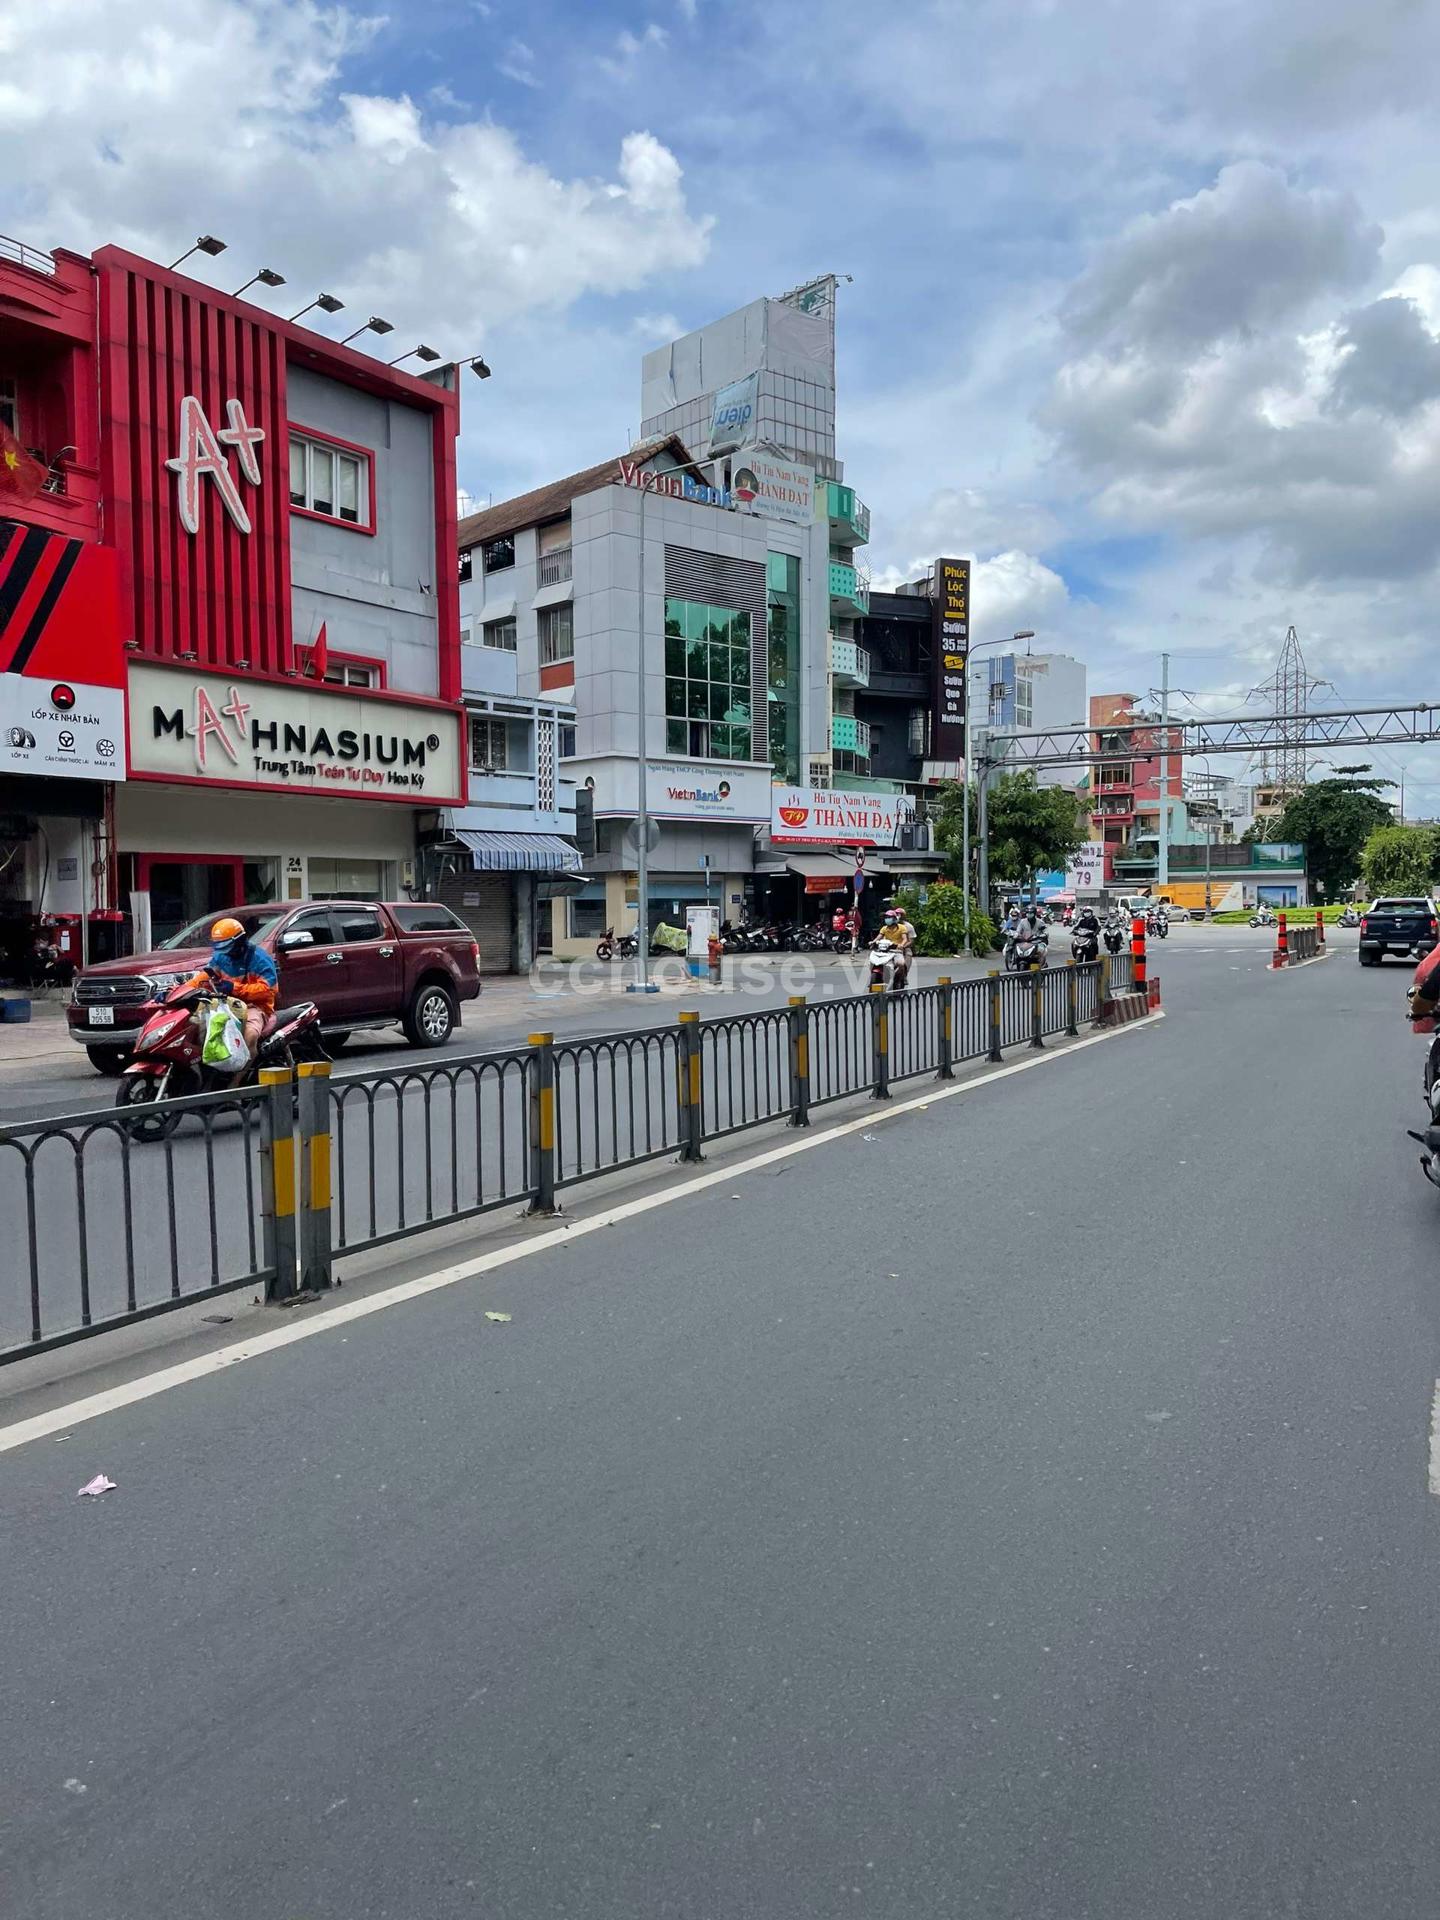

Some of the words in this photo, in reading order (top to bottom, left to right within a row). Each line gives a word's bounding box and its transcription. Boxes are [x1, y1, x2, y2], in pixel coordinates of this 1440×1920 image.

[618, 459, 733, 509] VietinBank
[758, 479, 786, 501] HÀNH
[944, 566, 967, 578] Phúc
[947, 580, 964, 594] Lộc
[947, 596, 965, 611] Thọ
[48, 713, 59, 721] XE
[254, 756, 290, 777] Trung
[290, 760, 317, 776] Tâm
[317, 763, 345, 779] Toán
[362, 769, 386, 786] Duy
[387, 771, 410, 785] Hoa
[668, 787, 720, 802] VietinBank
[843, 794, 861, 806] Nam
[862, 796, 881, 809] Vang
[814, 805, 868, 828] THÀNH
[289, 857, 301, 867] 24
[1076, 871, 1091, 885] 79
